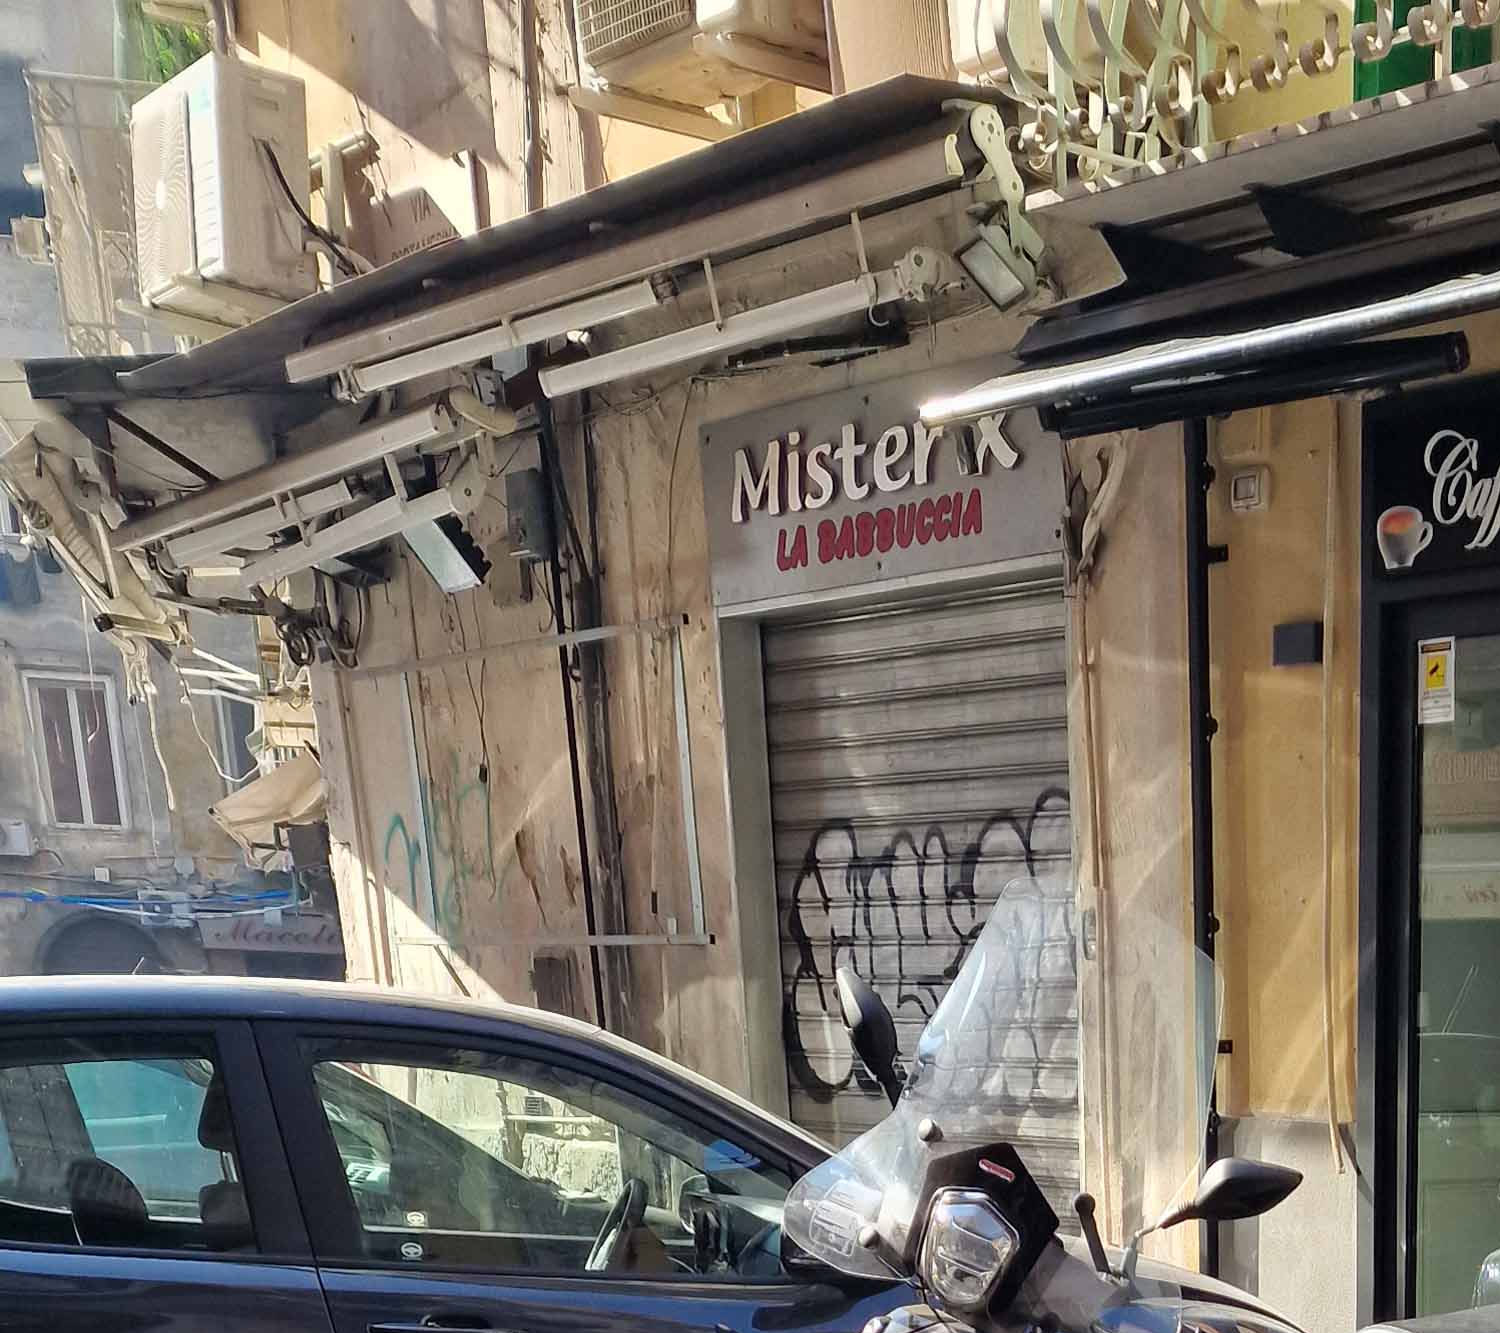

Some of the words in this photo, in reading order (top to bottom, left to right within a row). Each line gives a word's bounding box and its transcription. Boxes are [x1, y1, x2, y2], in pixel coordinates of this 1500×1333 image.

[731, 418, 944, 523] Mister
[776, 524, 809, 571] LA
[817, 488, 983, 564] BABBUCCIA
